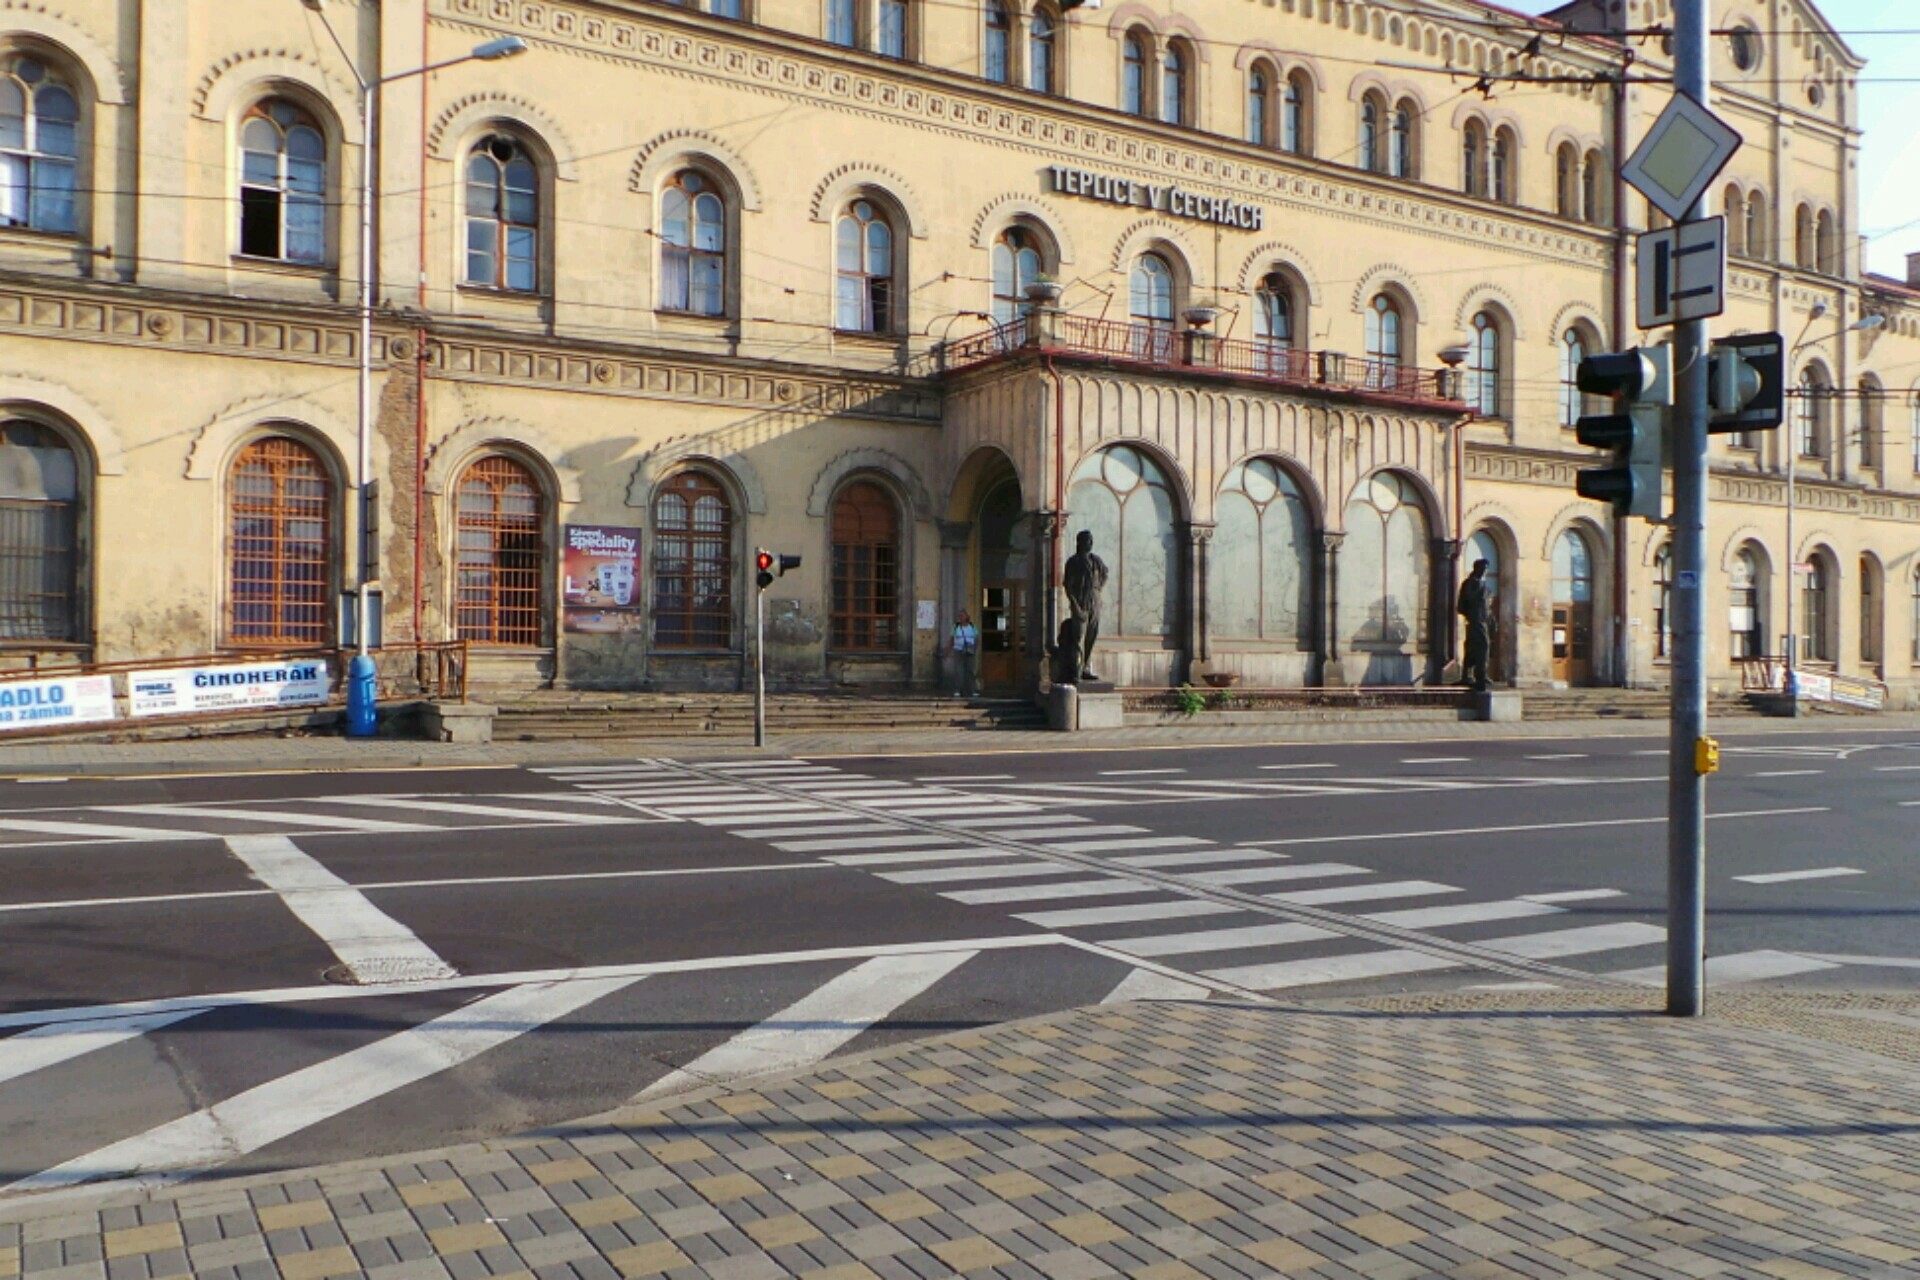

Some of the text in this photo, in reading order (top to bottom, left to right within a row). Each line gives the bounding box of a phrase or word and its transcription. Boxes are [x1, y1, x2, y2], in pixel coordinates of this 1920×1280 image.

[1051, 165, 1139, 205] TEPLICE
[1148, 184, 1161, 209] V
[570, 535, 635, 551] speciality
